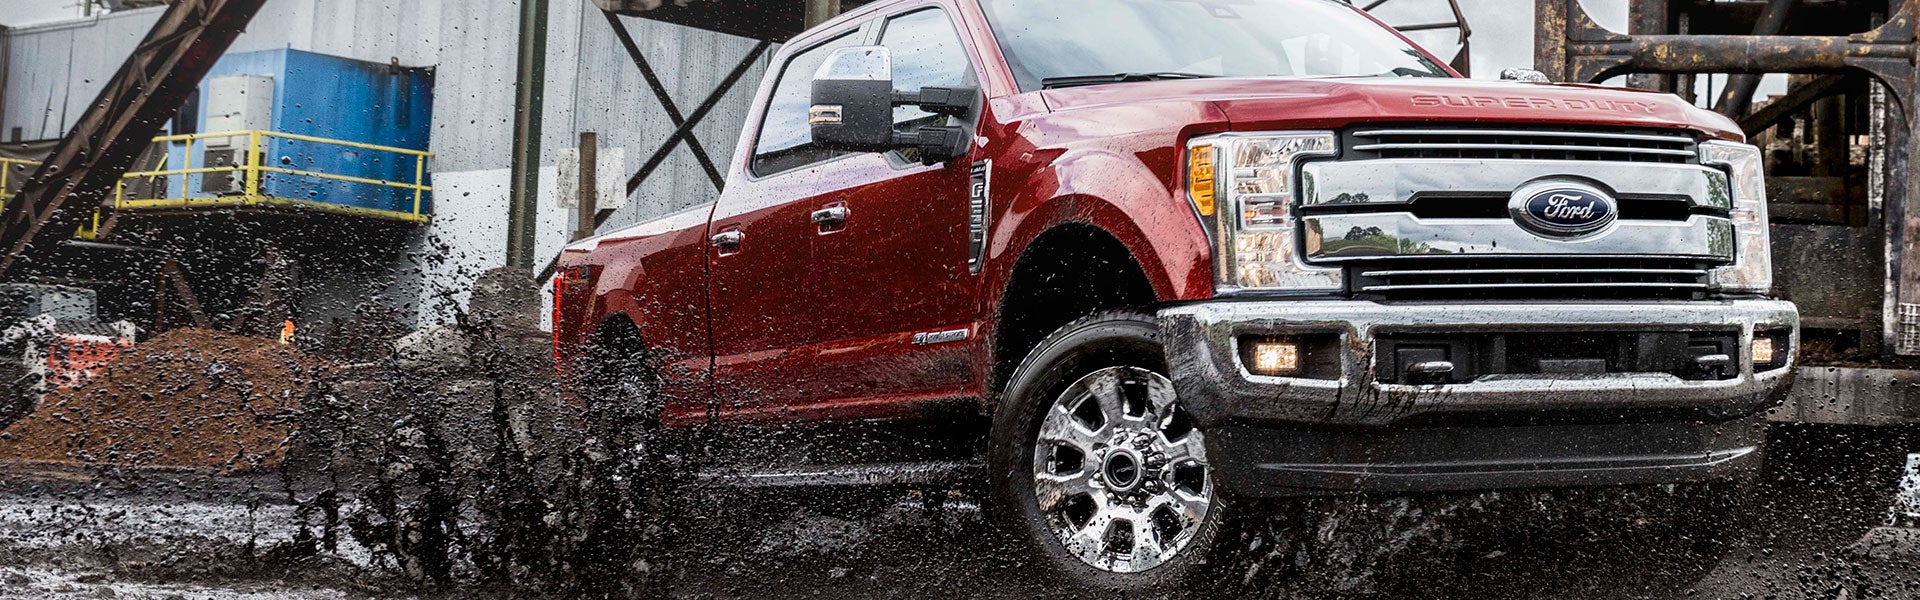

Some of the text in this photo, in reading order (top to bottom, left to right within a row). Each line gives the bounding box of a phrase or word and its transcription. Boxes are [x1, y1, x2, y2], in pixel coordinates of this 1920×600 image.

[1410, 95, 1656, 113] SUPER DUTY
[1544, 194, 1595, 219] Ford
